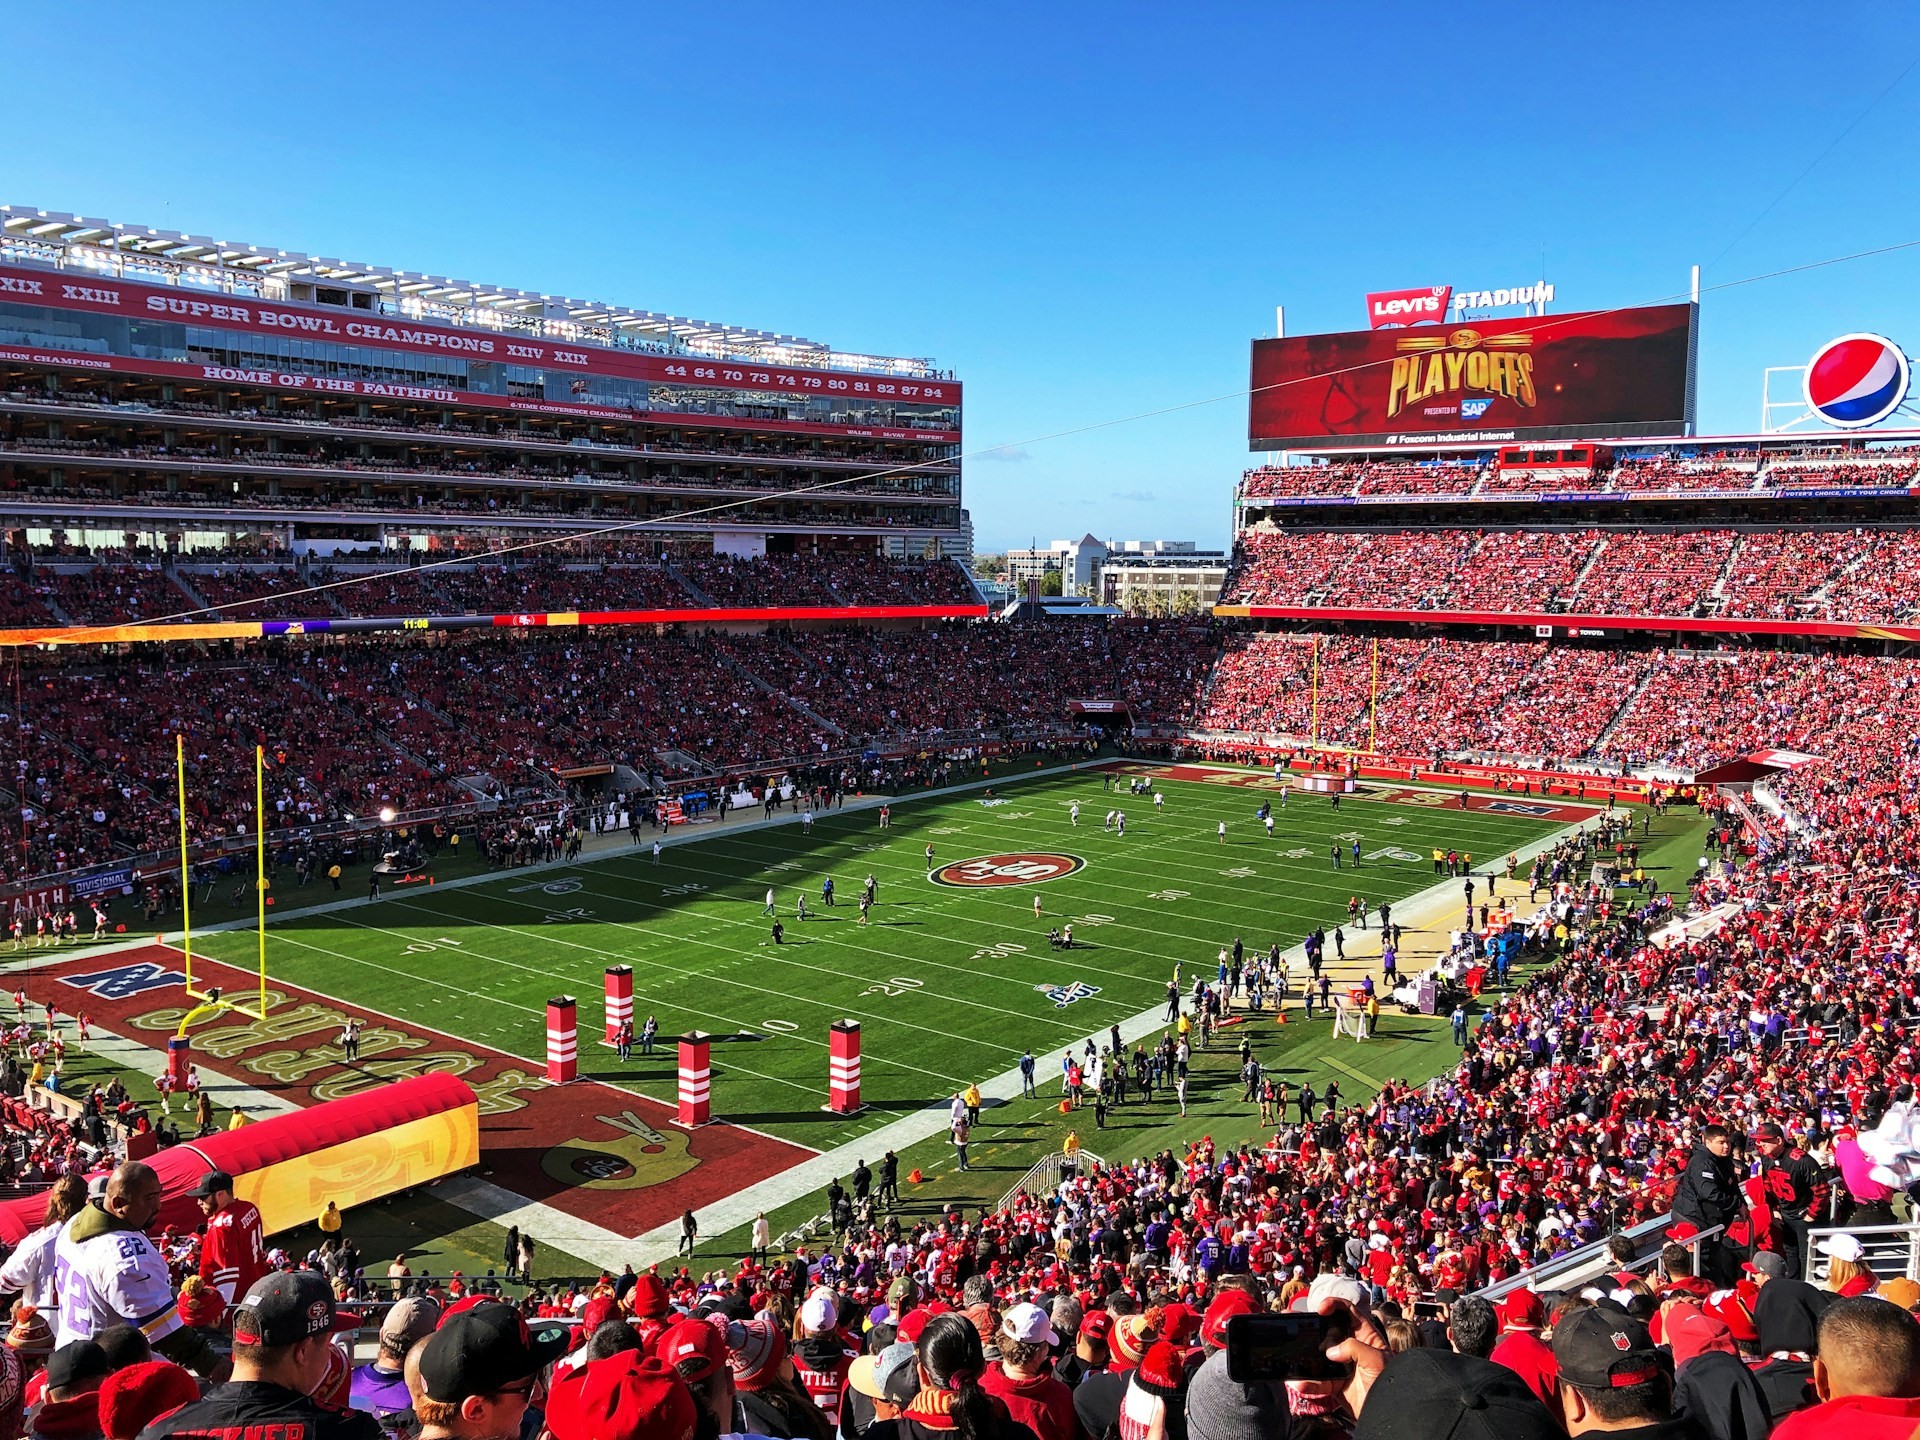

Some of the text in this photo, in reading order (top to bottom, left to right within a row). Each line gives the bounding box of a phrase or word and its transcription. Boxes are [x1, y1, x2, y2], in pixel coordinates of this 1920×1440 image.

[62, 284, 120, 305] XXIII
[1454, 284, 1555, 310] STADIUM
[147, 296, 495, 354] SUPER BOWL CHAMPIONS
[33, 354, 111, 368] CHAMPIONS
[507, 344, 588, 365] XXIV XXIX
[203, 367, 459, 402] HOME OF THE FAITHFUL
[665, 365, 942, 398] 44 64 70 73 74 79 80 81 82 87 94
[1387, 351, 1537, 418] PLAYOFFS
[510, 402, 633, 419] 6-TIME CONFERENCE CHAMPIONS
[1424, 407, 1450, 416] PRESENTED
[1461, 403, 1488, 417] SAP
[1399, 434, 1436, 443] Foxconn
[1437, 433, 1478, 442] Industrial
[1479, 431, 1515, 441] Internet
[402, 618, 429, 630] 11:08
[76, 874, 126, 892] DIVISIONAL
[13, 888, 63, 915] AITH
[976, 942, 1027, 959] 30
[868, 977, 924, 997] 20
[1562, 1165, 1574, 1177] 10
[1767, 1169, 1796, 1202] 85
[115, 1236, 148, 1260] 22
[1208, 1247, 1219, 1259] 19
[941, 1274, 952, 1285] 85
[306, 1314, 330, 1334] 1946
